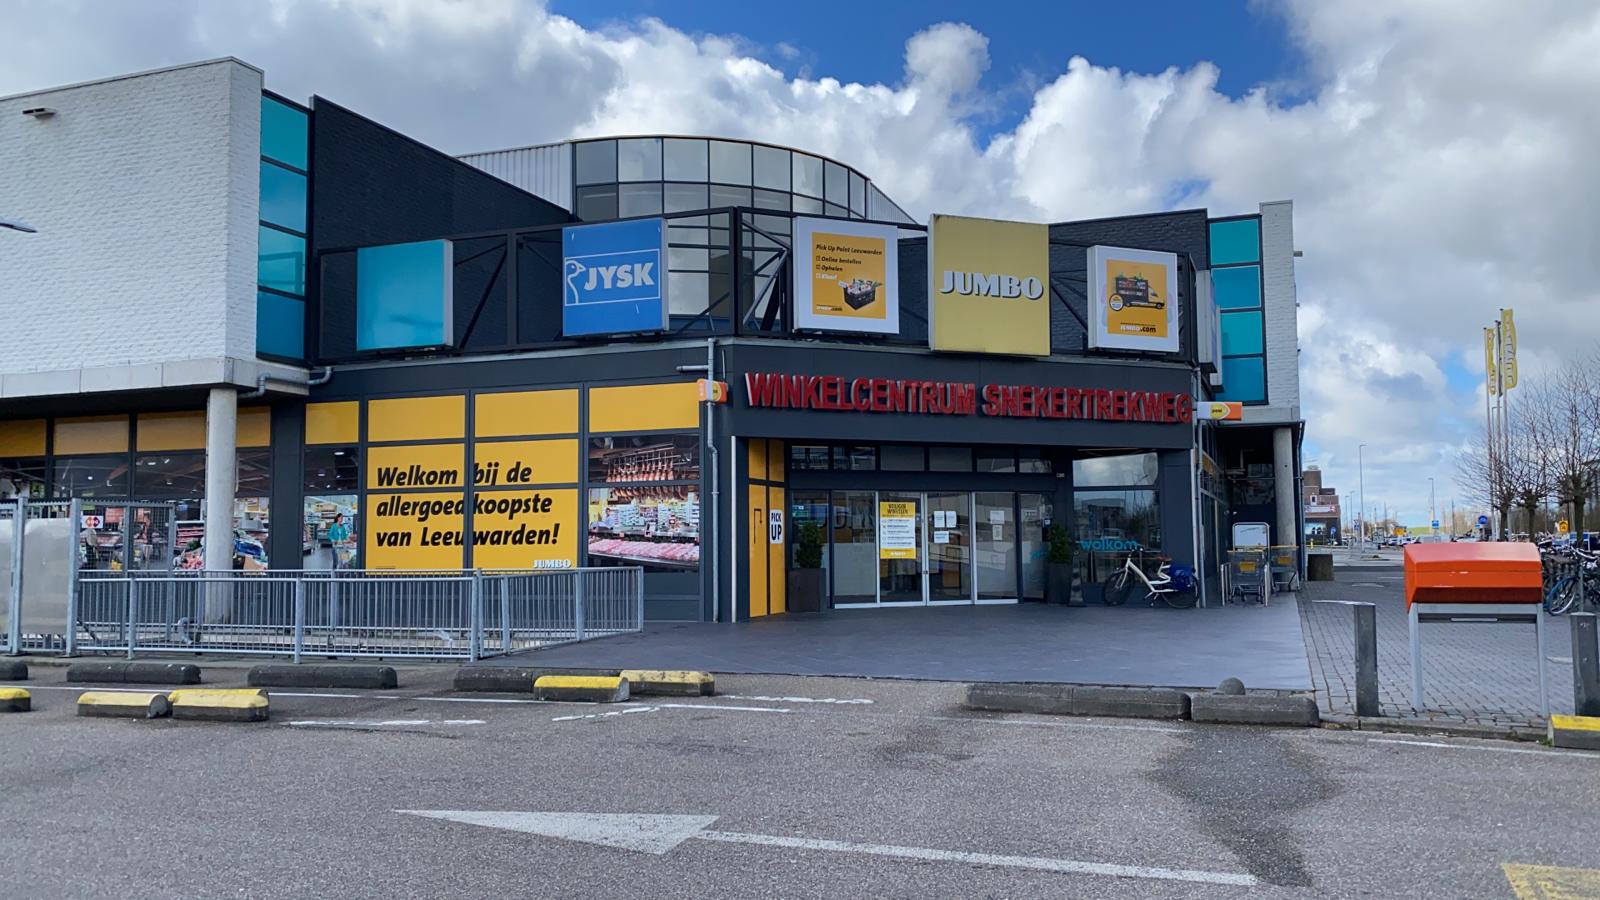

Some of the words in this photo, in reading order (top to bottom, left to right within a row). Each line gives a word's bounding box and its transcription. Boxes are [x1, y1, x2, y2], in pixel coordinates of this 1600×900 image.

[584, 262, 655, 291] JYSK
[940, 270, 1044, 300] JUMBO
[745, 372, 976, 415] WINKELCENTRUM
[982, 383, 1192, 423] SNEKERTREKWEG
[377, 465, 458, 486] Welkom
[474, 462, 499, 486] bij
[506, 461, 532, 483] de
[771, 512, 782, 522] PICK
[376, 531, 411, 547] van
[420, 523, 560, 547] Leeuwarden!
[771, 523, 782, 540] UP
[533, 559, 572, 568] JUMBO
